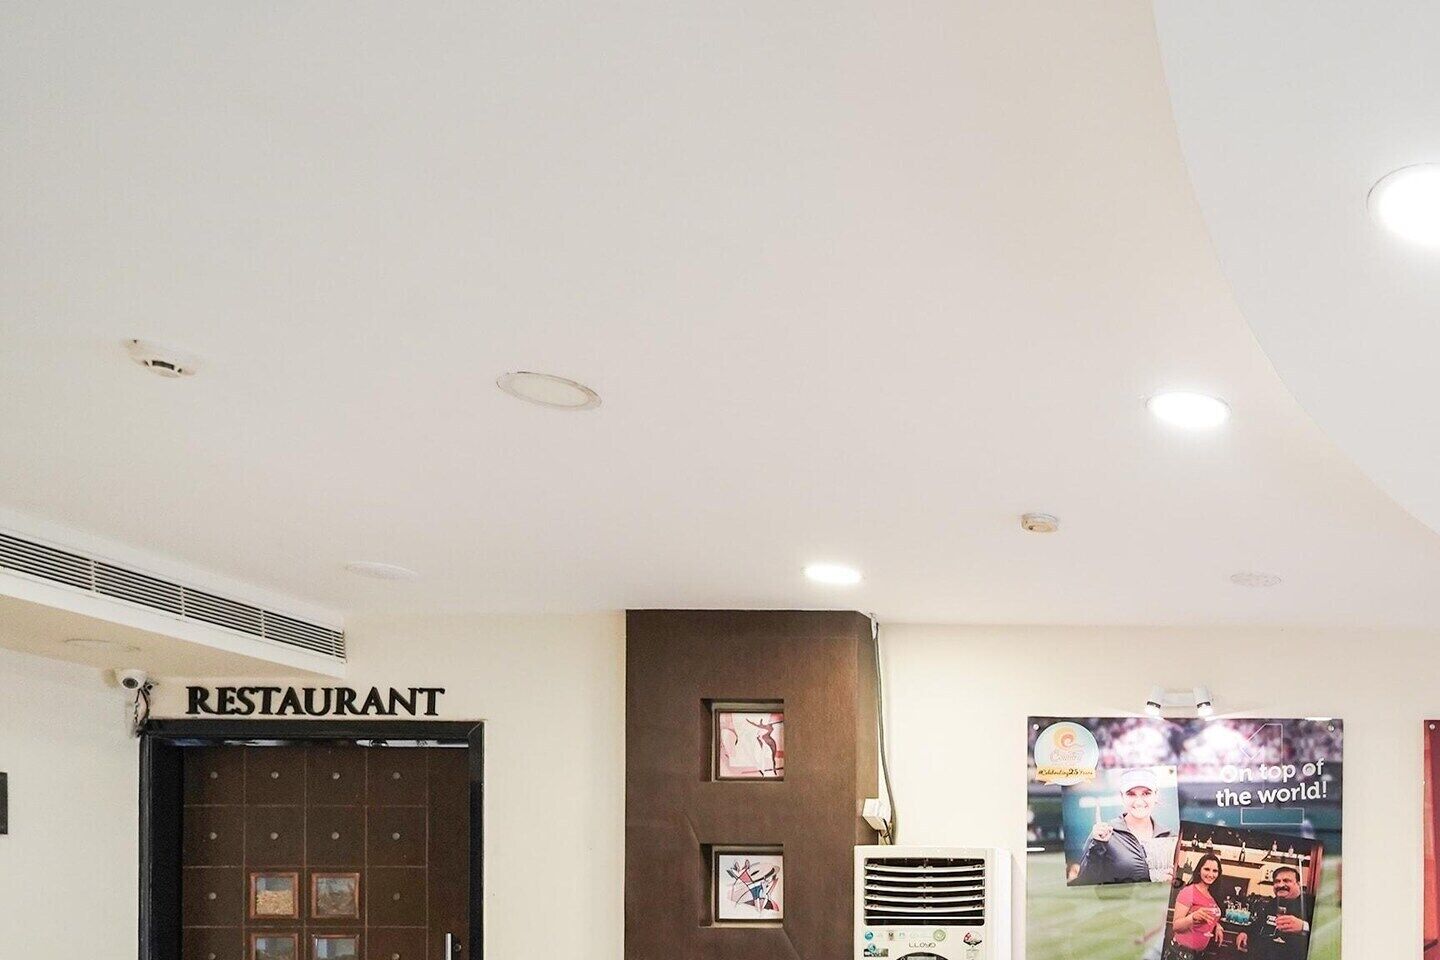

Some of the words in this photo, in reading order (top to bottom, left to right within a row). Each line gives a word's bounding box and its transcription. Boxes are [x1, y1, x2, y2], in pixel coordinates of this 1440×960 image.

[185, 686, 446, 716] RESTAURANT
[1220, 764, 1253, 783] On
[1259, 763, 1296, 783] top
[1302, 757, 1325, 777] of
[1215, 788, 1252, 807] the
[1257, 780, 1328, 804] world!
